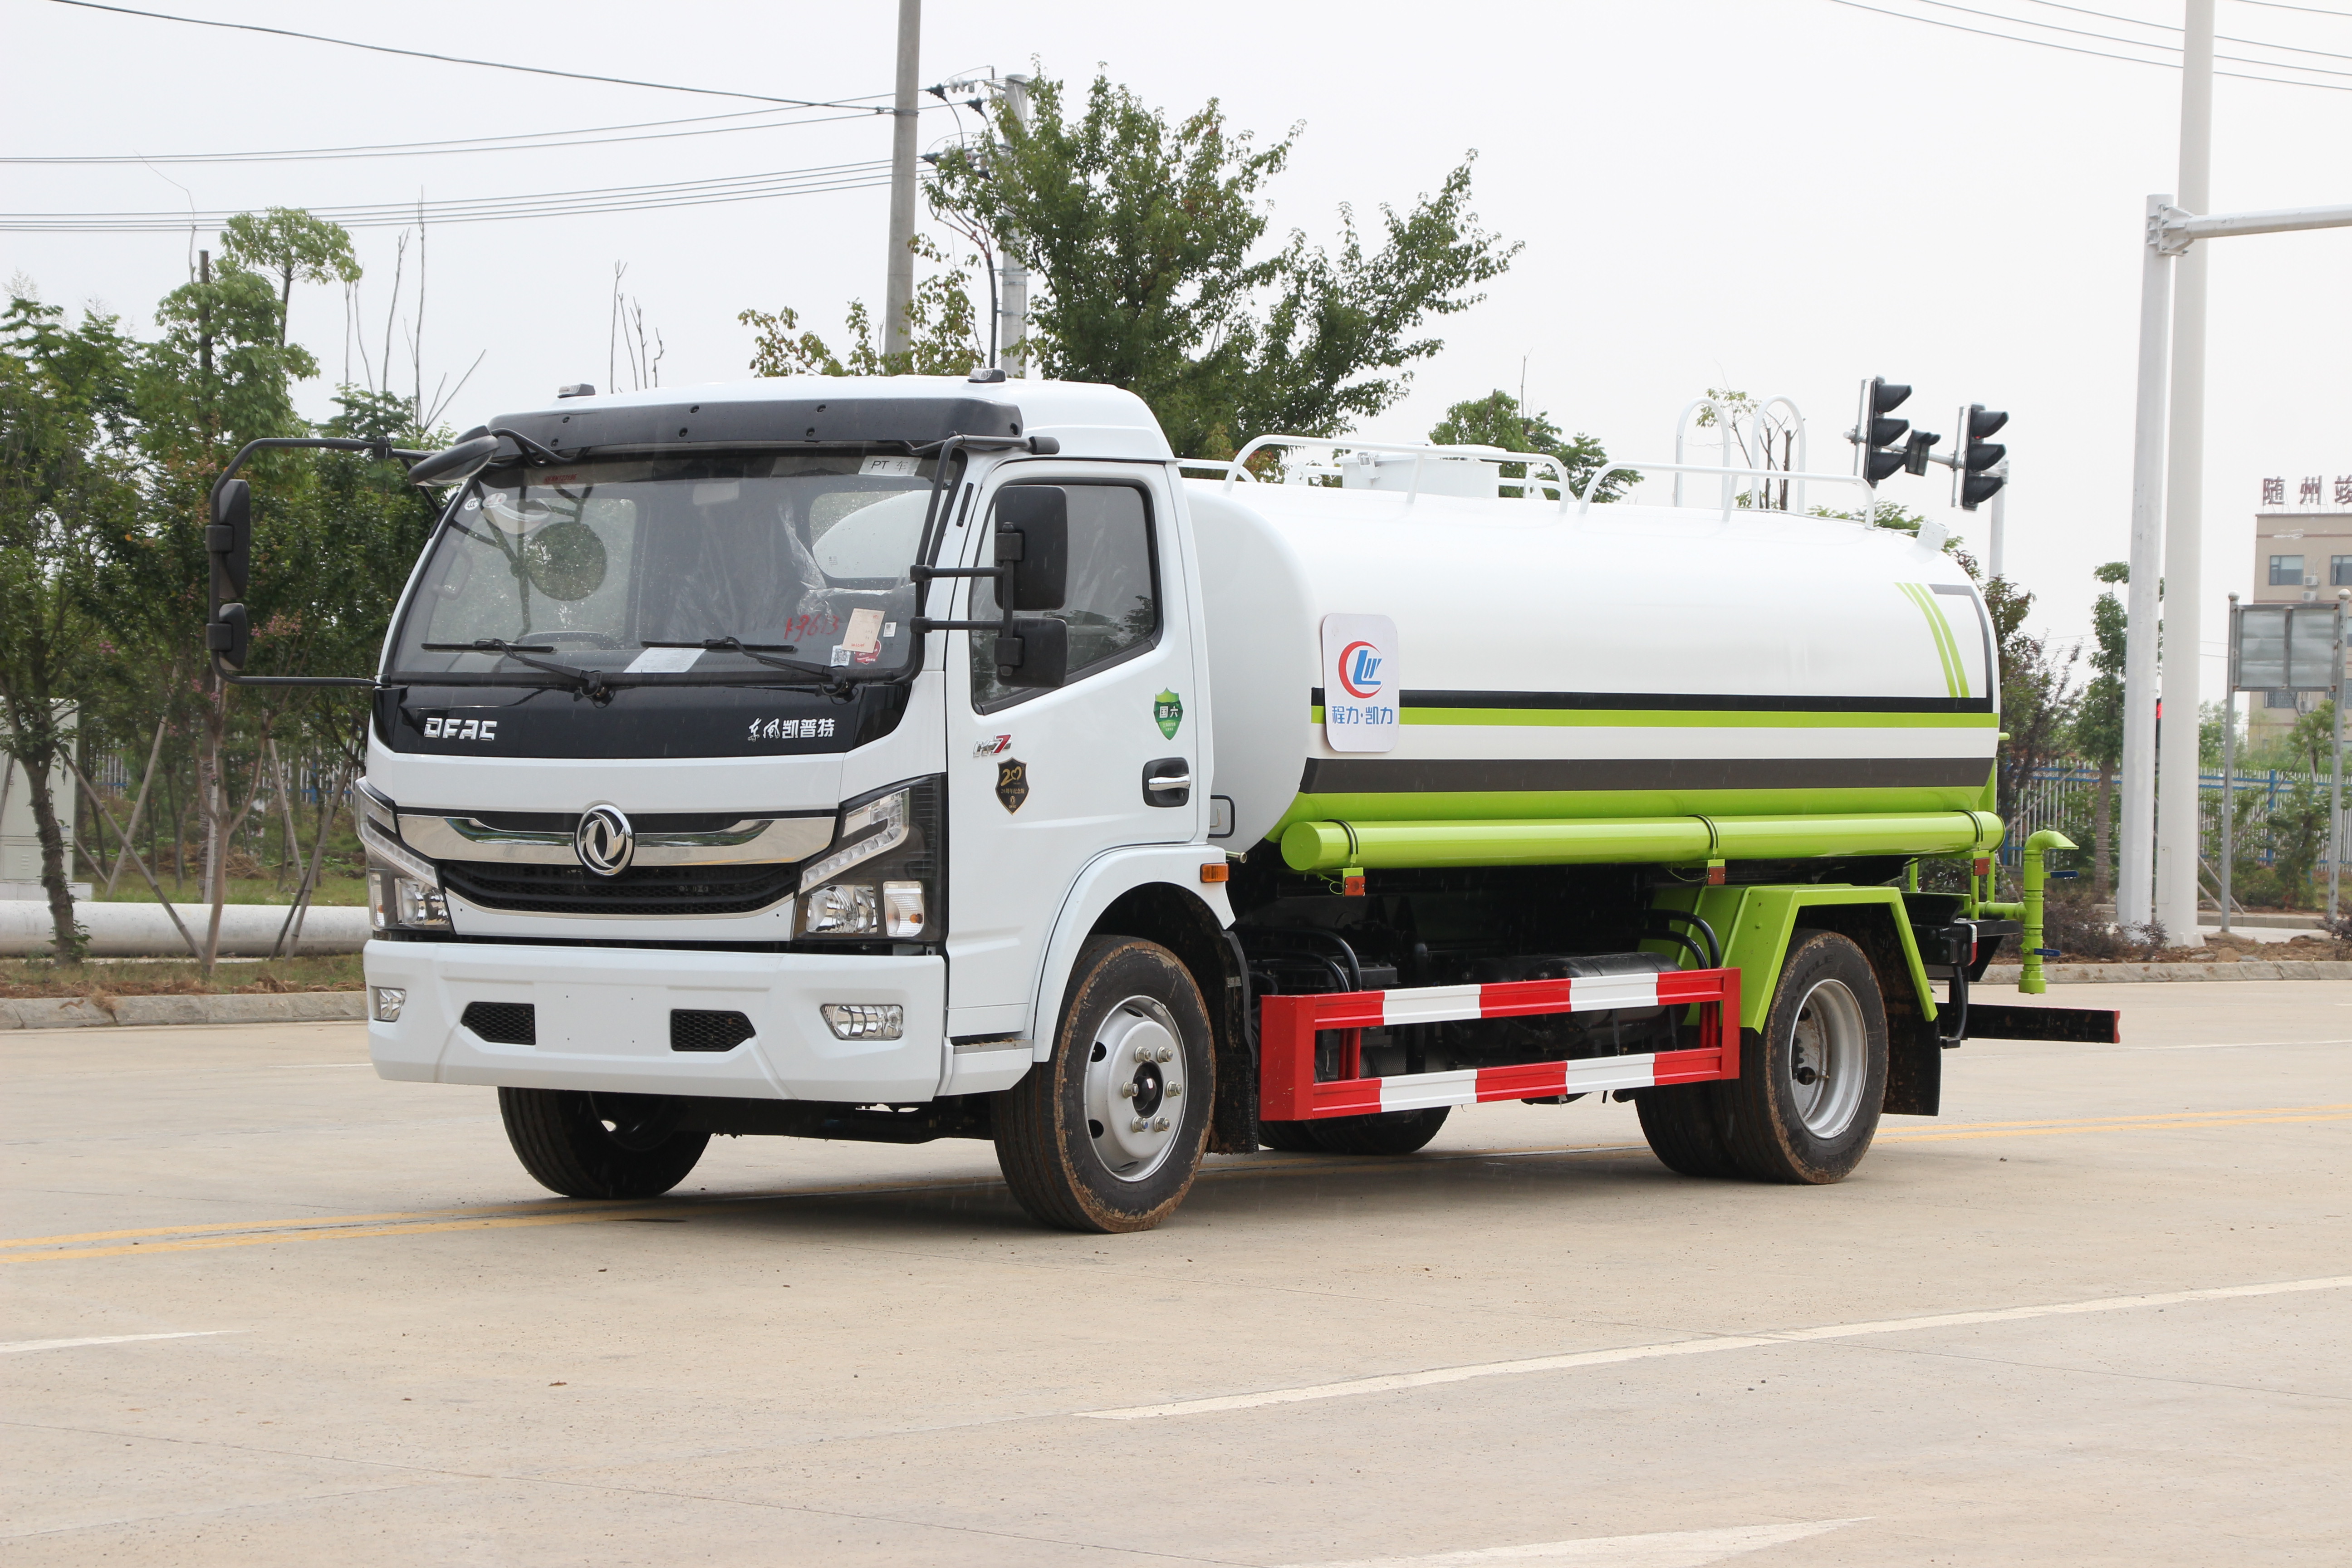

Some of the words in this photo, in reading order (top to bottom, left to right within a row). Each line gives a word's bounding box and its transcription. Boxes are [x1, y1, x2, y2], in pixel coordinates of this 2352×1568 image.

[871, 461, 890, 470] PT
[1159, 706, 1179, 718] 国六
[1331, 706, 1393, 725] 程力·凯力
[424, 717, 498, 741] DFAC
